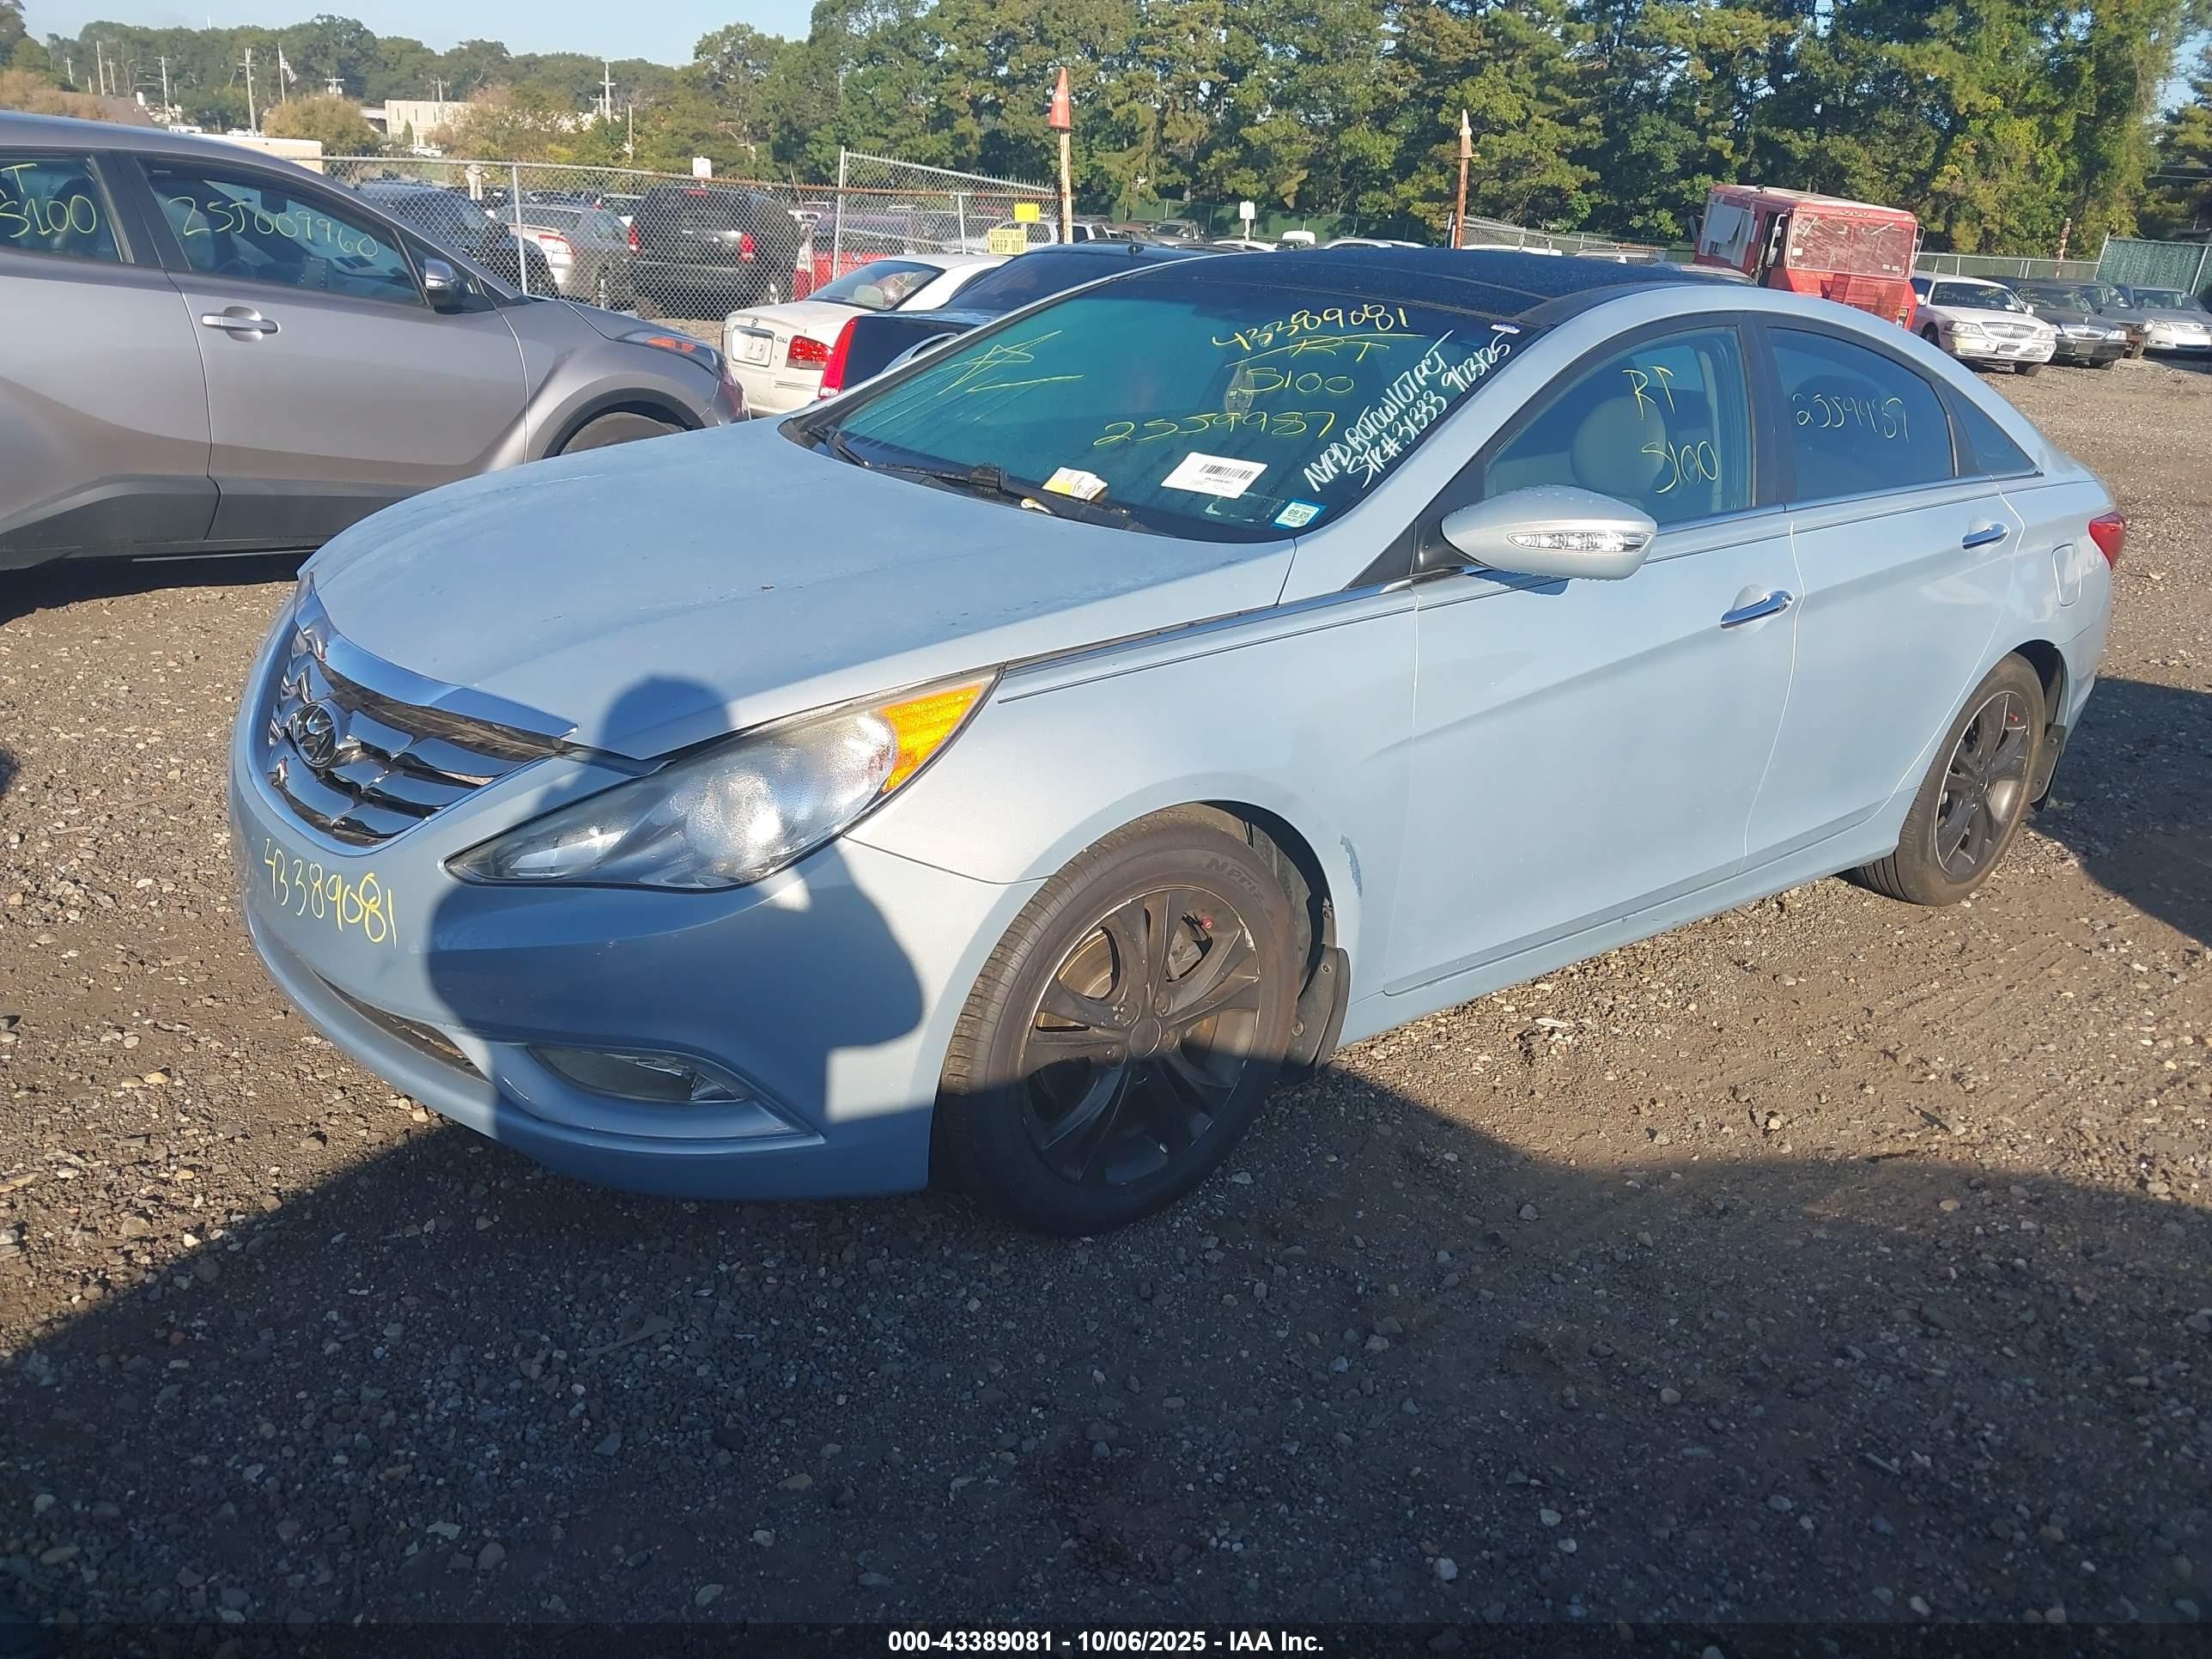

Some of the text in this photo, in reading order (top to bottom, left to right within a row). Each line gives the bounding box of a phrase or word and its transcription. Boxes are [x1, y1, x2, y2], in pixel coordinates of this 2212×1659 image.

[991, 240, 1024, 252] KEEP OUT
[1212, 303, 1409, 350] 43389081
[1291, 335, 1390, 362] RT
[1238, 367, 1355, 393] S100
[1621, 366, 1677, 421] RT
[1303, 441, 1352, 492] NYPD
[264, 838, 398, 950] 43389081
